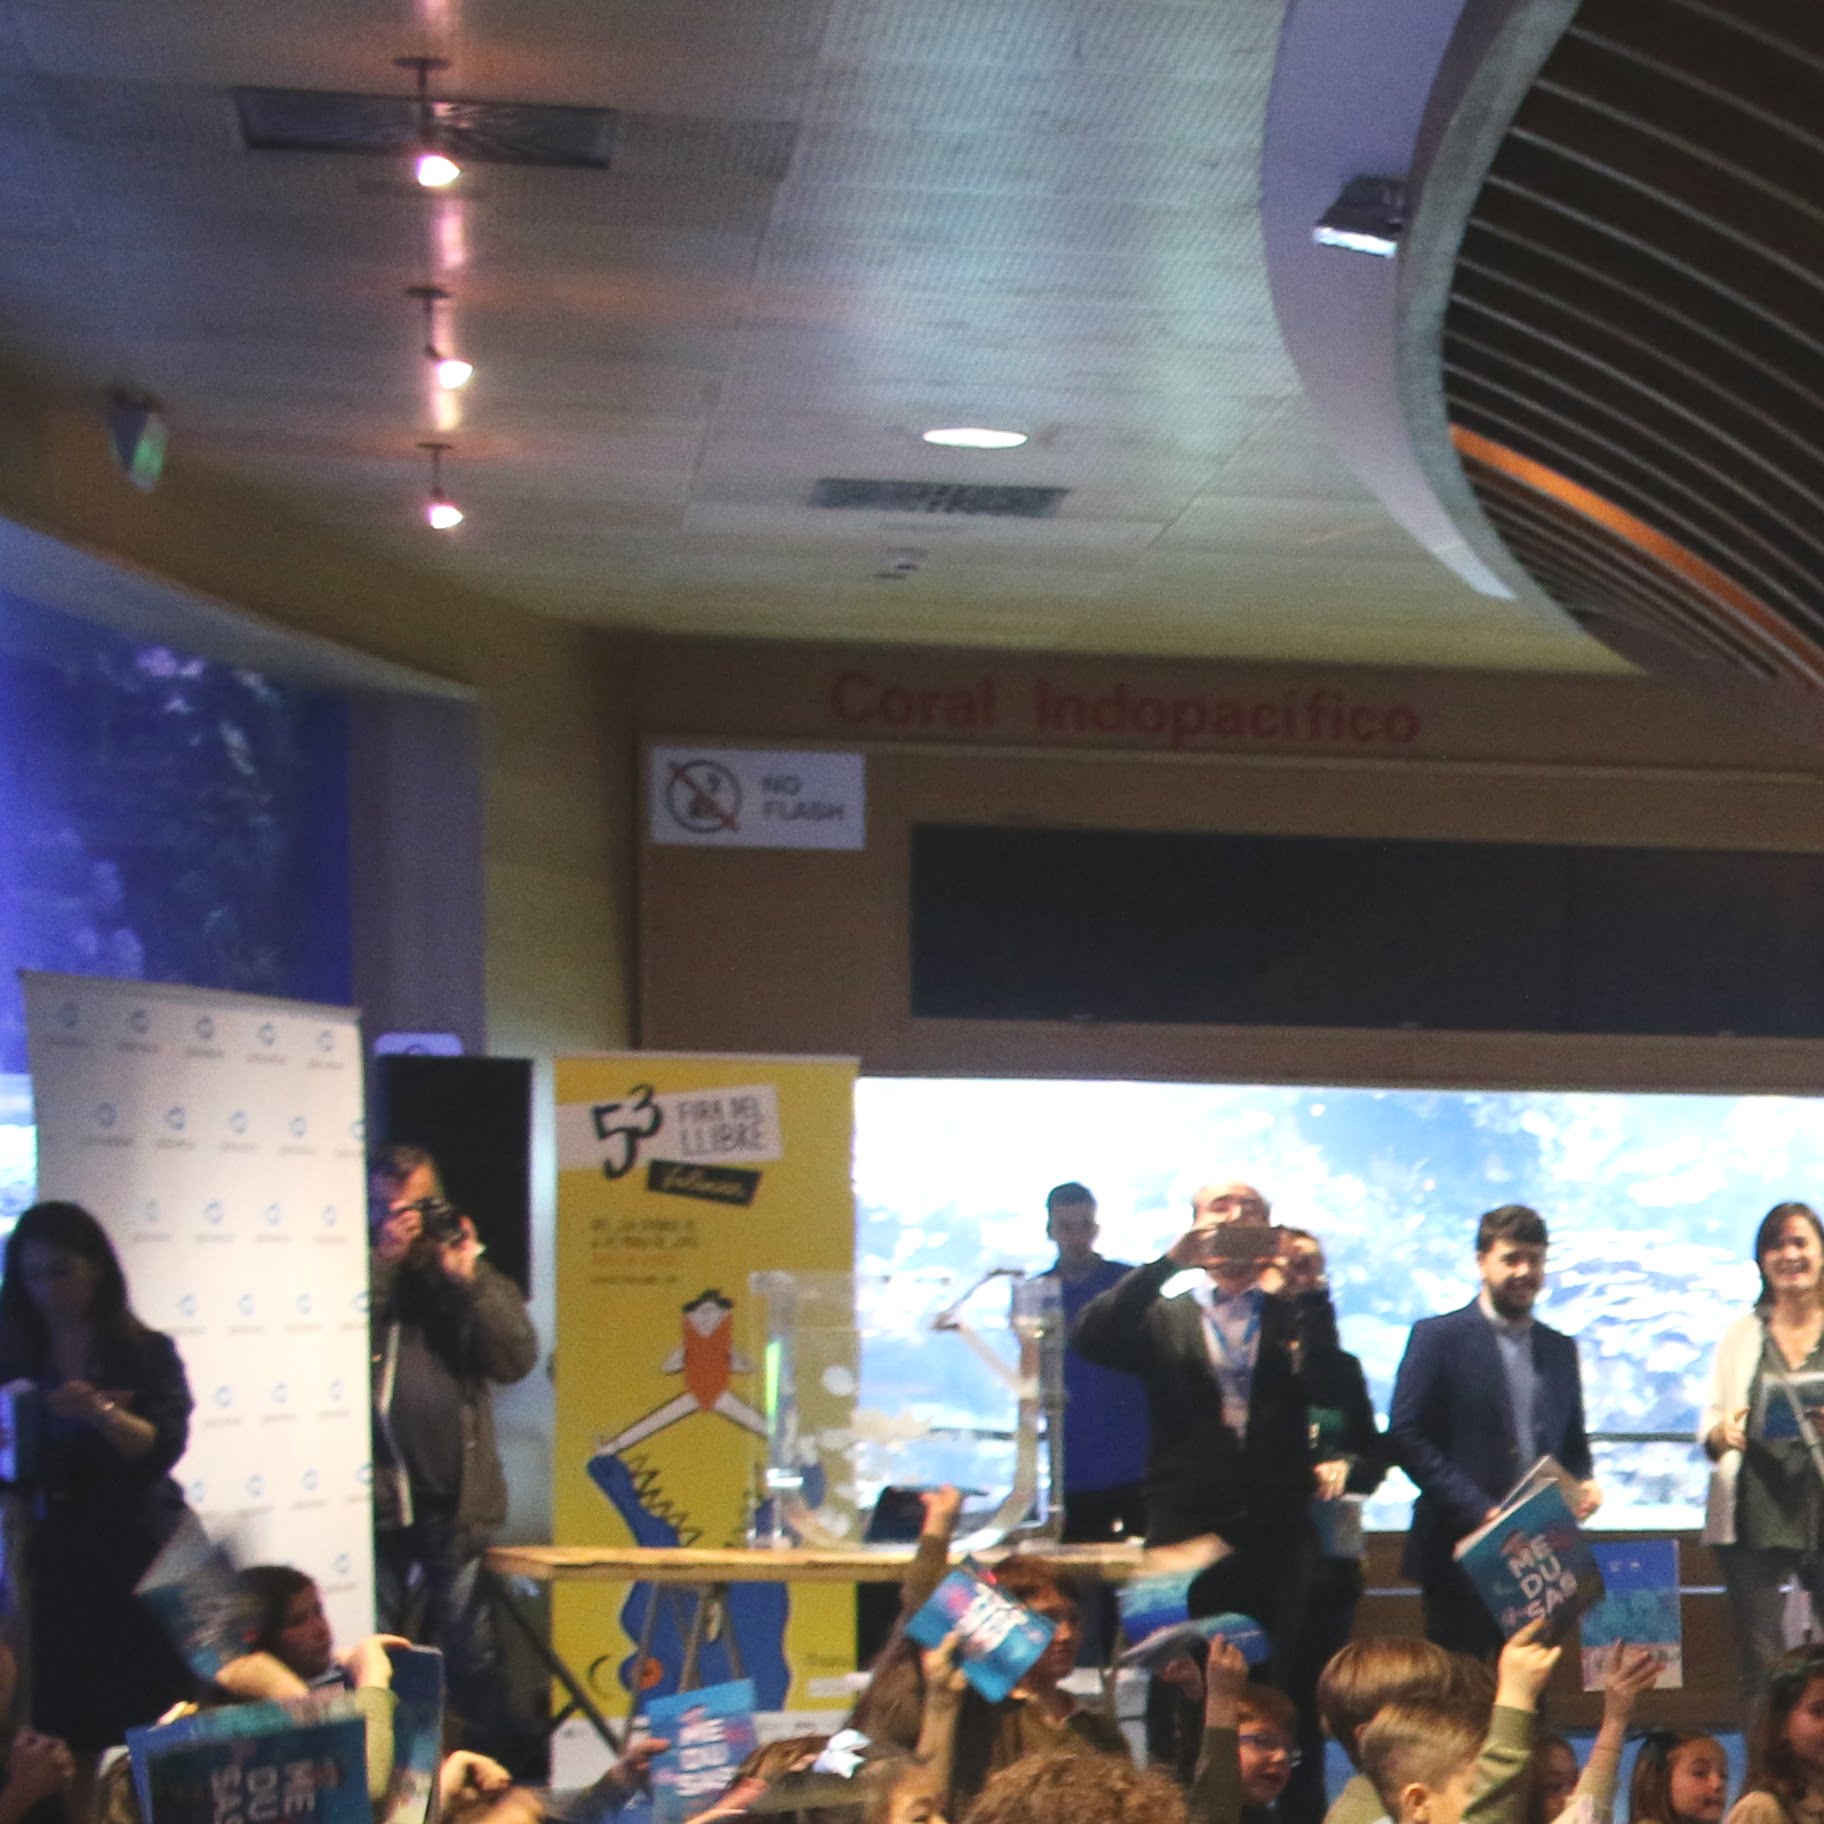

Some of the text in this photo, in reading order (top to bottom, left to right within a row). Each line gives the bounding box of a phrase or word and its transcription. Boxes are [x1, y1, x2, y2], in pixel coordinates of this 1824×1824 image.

[829, 671, 995, 728] Coral
[761, 775, 801, 796] NO
[761, 800, 846, 823] FLASH
[590, 1082, 664, 1181] 53
[1507, 1534, 1551, 1579] ME
[1520, 1553, 1561, 1600] DU
